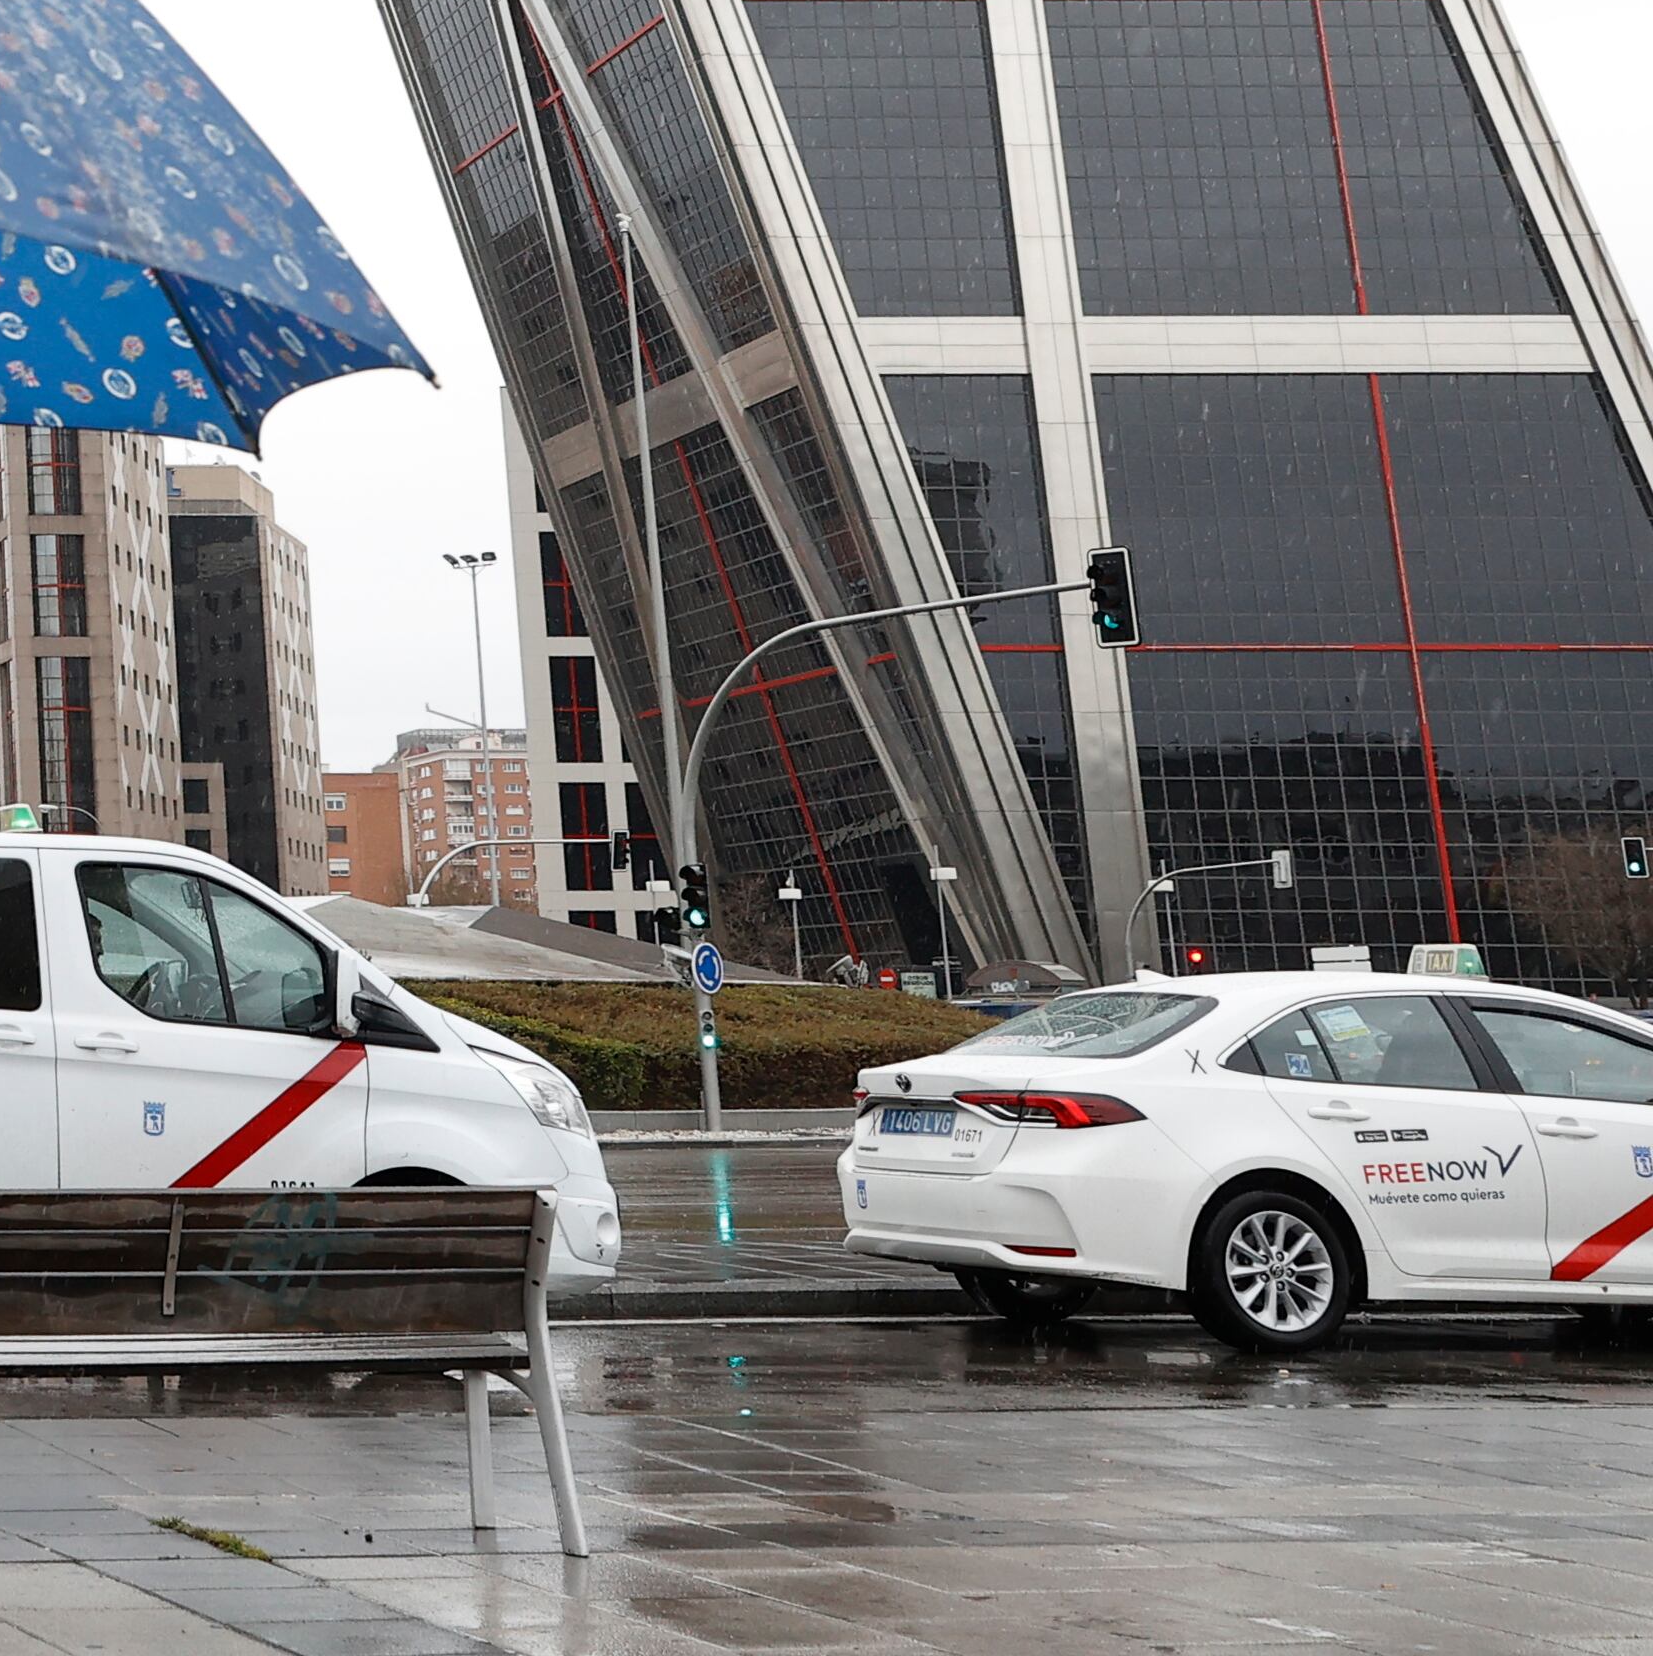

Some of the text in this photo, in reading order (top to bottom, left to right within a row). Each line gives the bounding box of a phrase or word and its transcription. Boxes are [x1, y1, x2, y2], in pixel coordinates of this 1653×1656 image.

[1427, 952, 1454, 972] TAXI
[889, 1109, 953, 1133] 1406 LVG
[954, 1128, 983, 1143] 01671
[1368, 1187, 1506, 1206] Muévete como quieras
